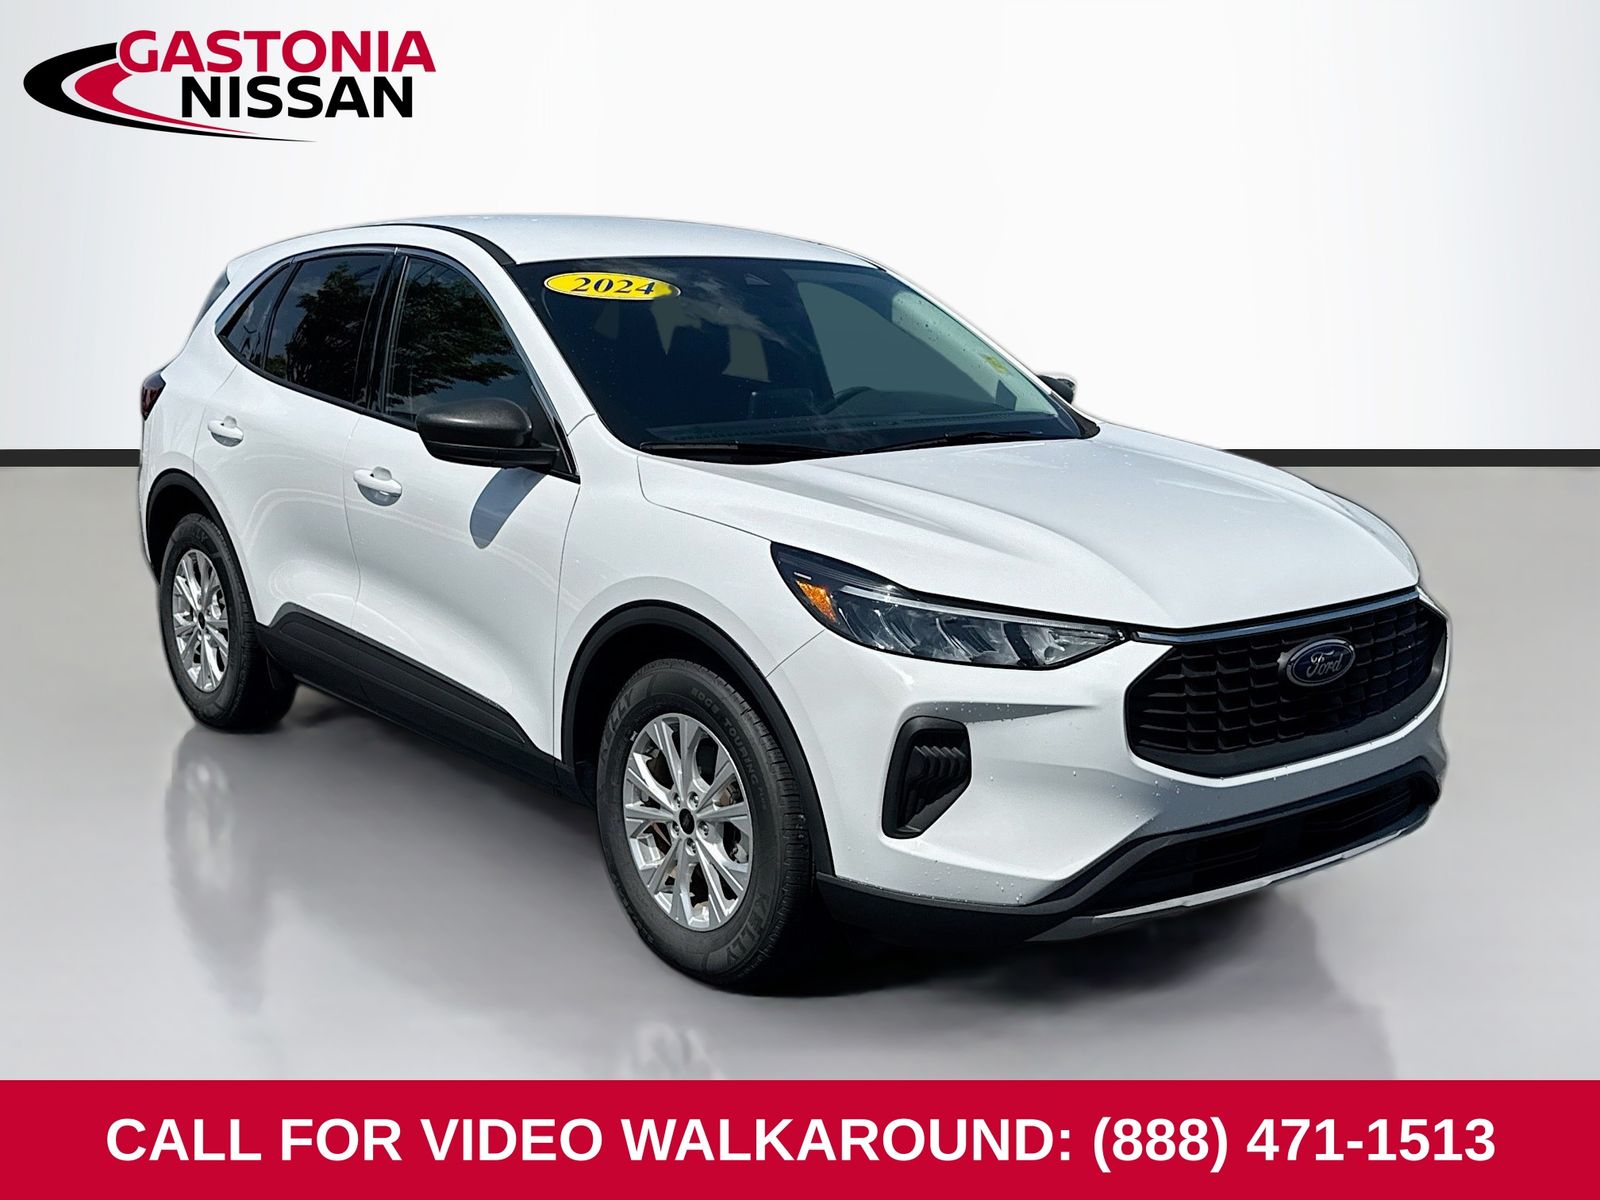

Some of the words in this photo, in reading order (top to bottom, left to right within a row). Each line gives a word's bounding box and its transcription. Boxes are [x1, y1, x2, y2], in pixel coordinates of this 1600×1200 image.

[571, 277, 656, 295] 2024
[1306, 650, 1344, 678] Ford
[725, 716, 758, 785] TOURING
